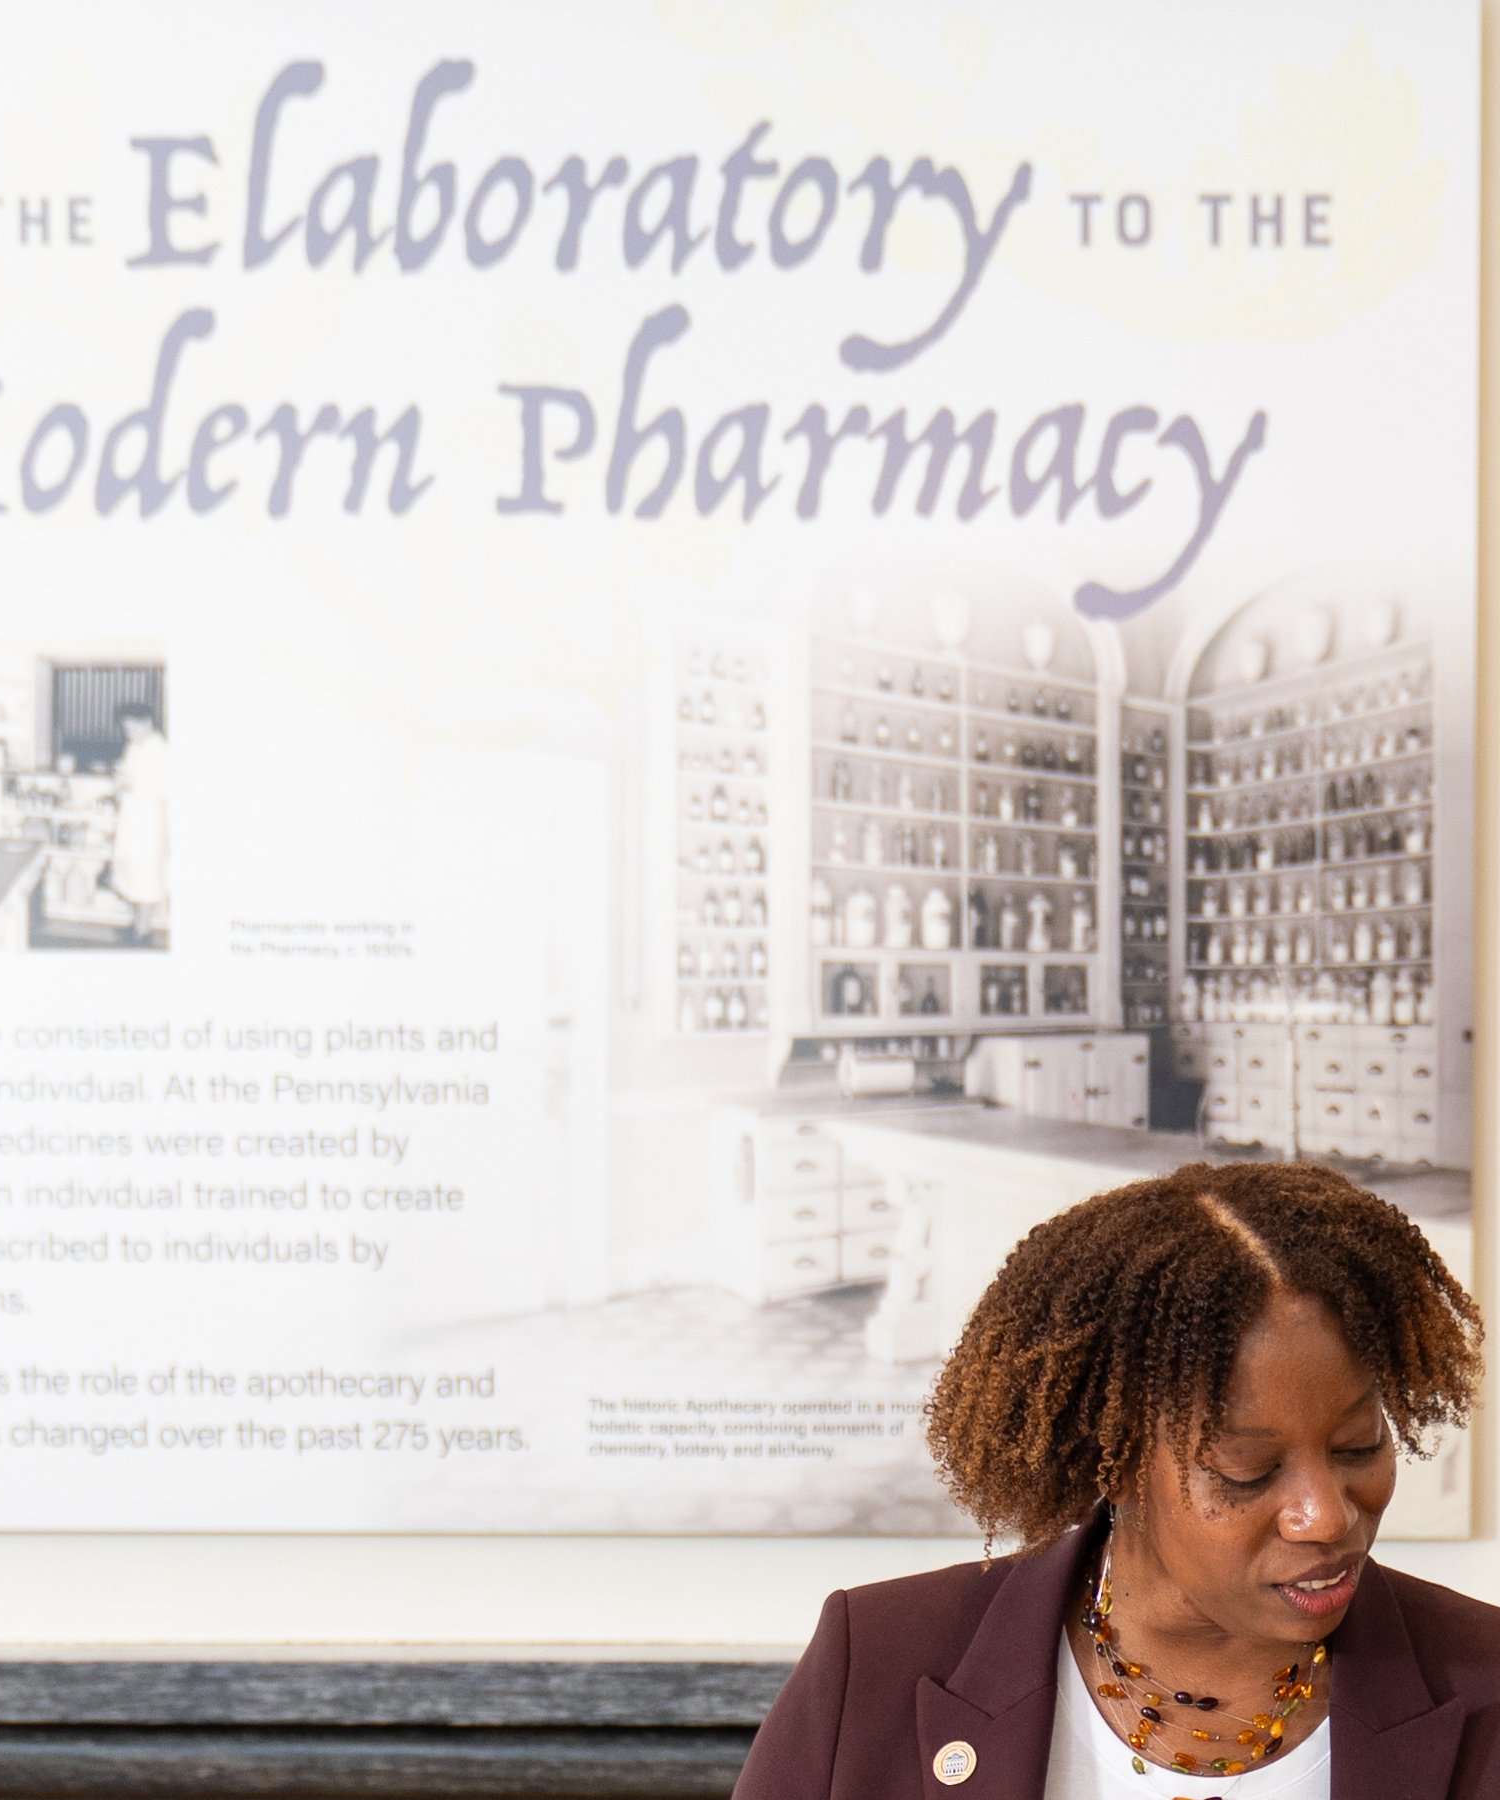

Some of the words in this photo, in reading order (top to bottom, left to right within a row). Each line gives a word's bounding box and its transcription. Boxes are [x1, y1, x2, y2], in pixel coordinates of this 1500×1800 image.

[125, 58, 1033, 374] Elaboratory
[1069, 193, 1154, 247] TO
[1199, 193, 1333, 247] THE
[497, 303, 1268, 622] Pharmacy
[11, 1020, 171, 1050] consisted
[181, 1019, 214, 1050] of
[223, 1022, 313, 1059] using
[323, 1021, 425, 1056] plants
[436, 1021, 499, 1052] and
[162, 1073, 197, 1103] At
[207, 1073, 261, 1104] the
[271, 1073, 490, 1112] Pennsylvania
[143, 1133, 224, 1157] were
[233, 1127, 359, 1157] created
[368, 1127, 410, 1165] by
[22, 1178, 183, 1210] individual
[192, 1179, 309, 1210] trained
[319, 1182, 351, 1210] to
[361, 1183, 464, 1211] create
[119, 1234, 152, 1263] to
[161, 1232, 338, 1263] individuals
[349, 1232, 389, 1271] by
[18, 1365, 70, 1395] the
[78, 1365, 138, 1396] role
[146, 1364, 178, 1396] of
[185, 1366, 236, 1396] the
[245, 1367, 426, 1405] apothecary
[434, 1367, 496, 1399] and
[8, 1417, 149, 1456] changed
[157, 1425, 225, 1449] over
[234, 1418, 286, 1449] the
[294, 1422, 363, 1455] past
[372, 1419, 429, 1451] 275
[437, 1426, 531, 1459] years.
